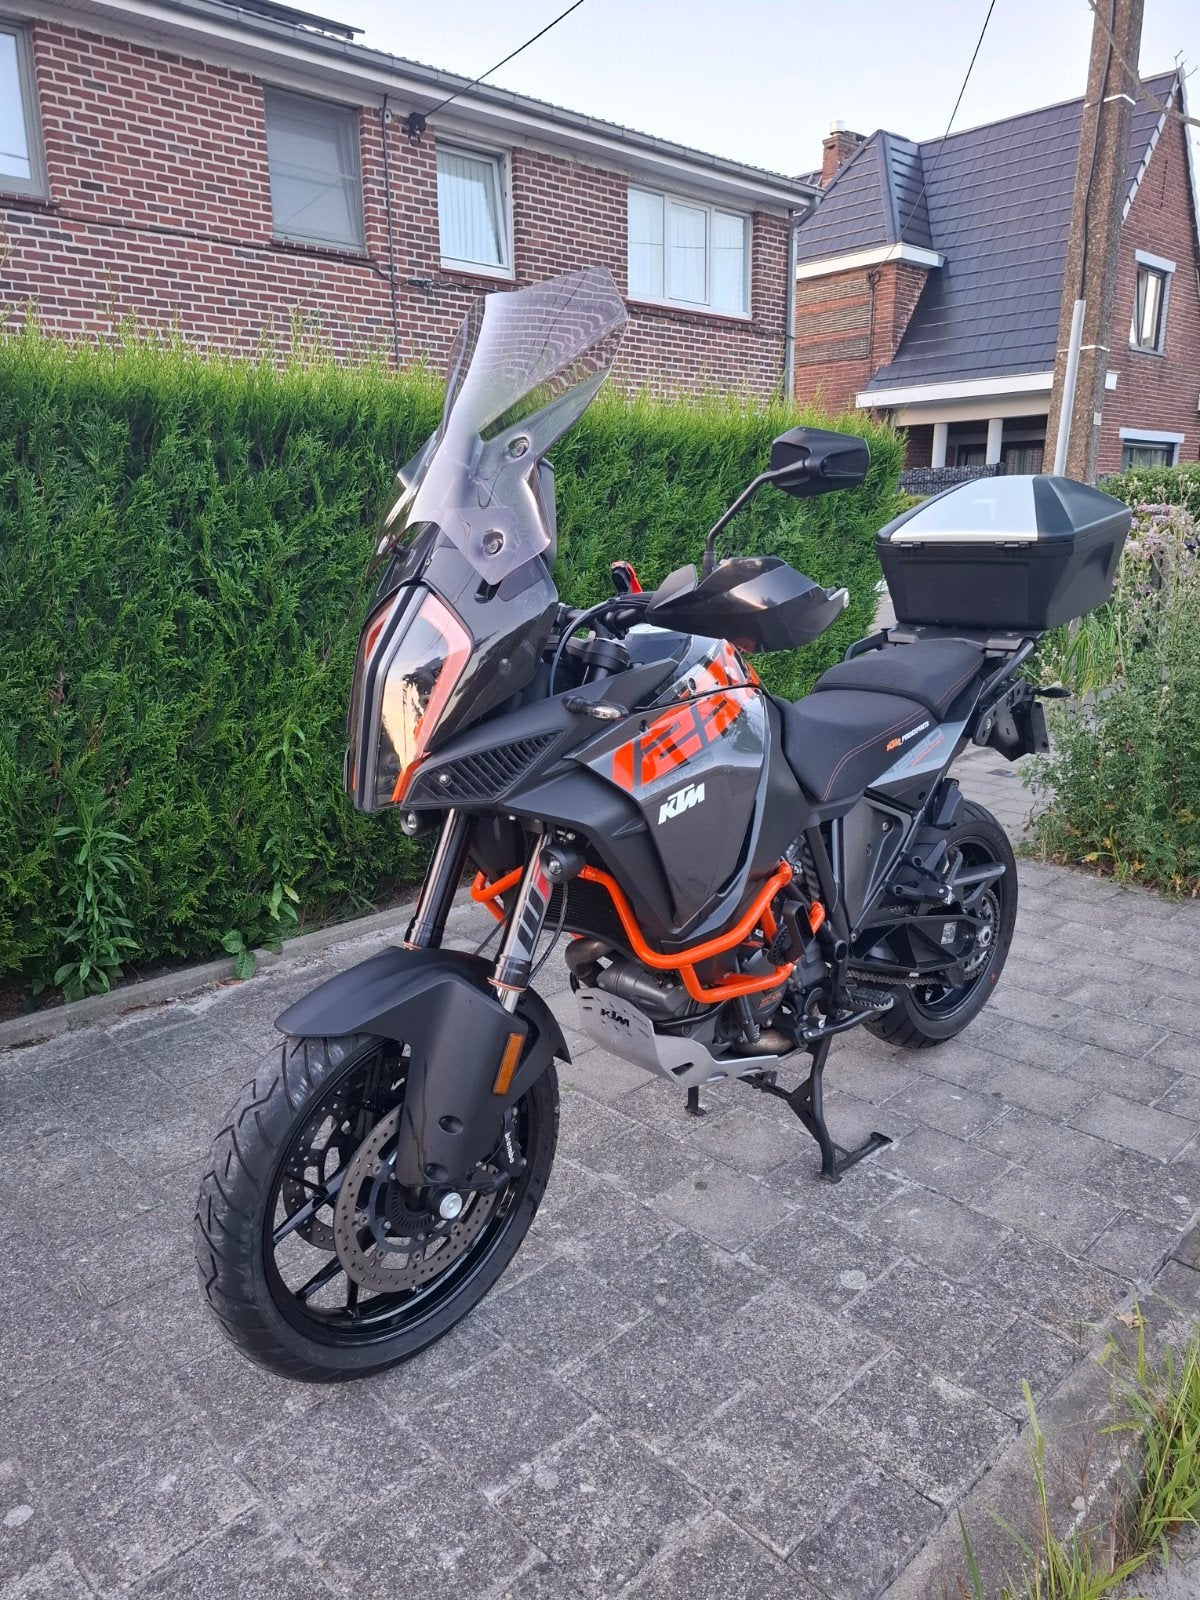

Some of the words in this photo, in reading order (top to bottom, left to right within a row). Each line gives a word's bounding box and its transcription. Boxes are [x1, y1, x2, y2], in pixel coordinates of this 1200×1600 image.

[658, 782, 706, 826] KTM
[600, 1007, 630, 1028] KTM
[504, 1131, 515, 1164] brembo
